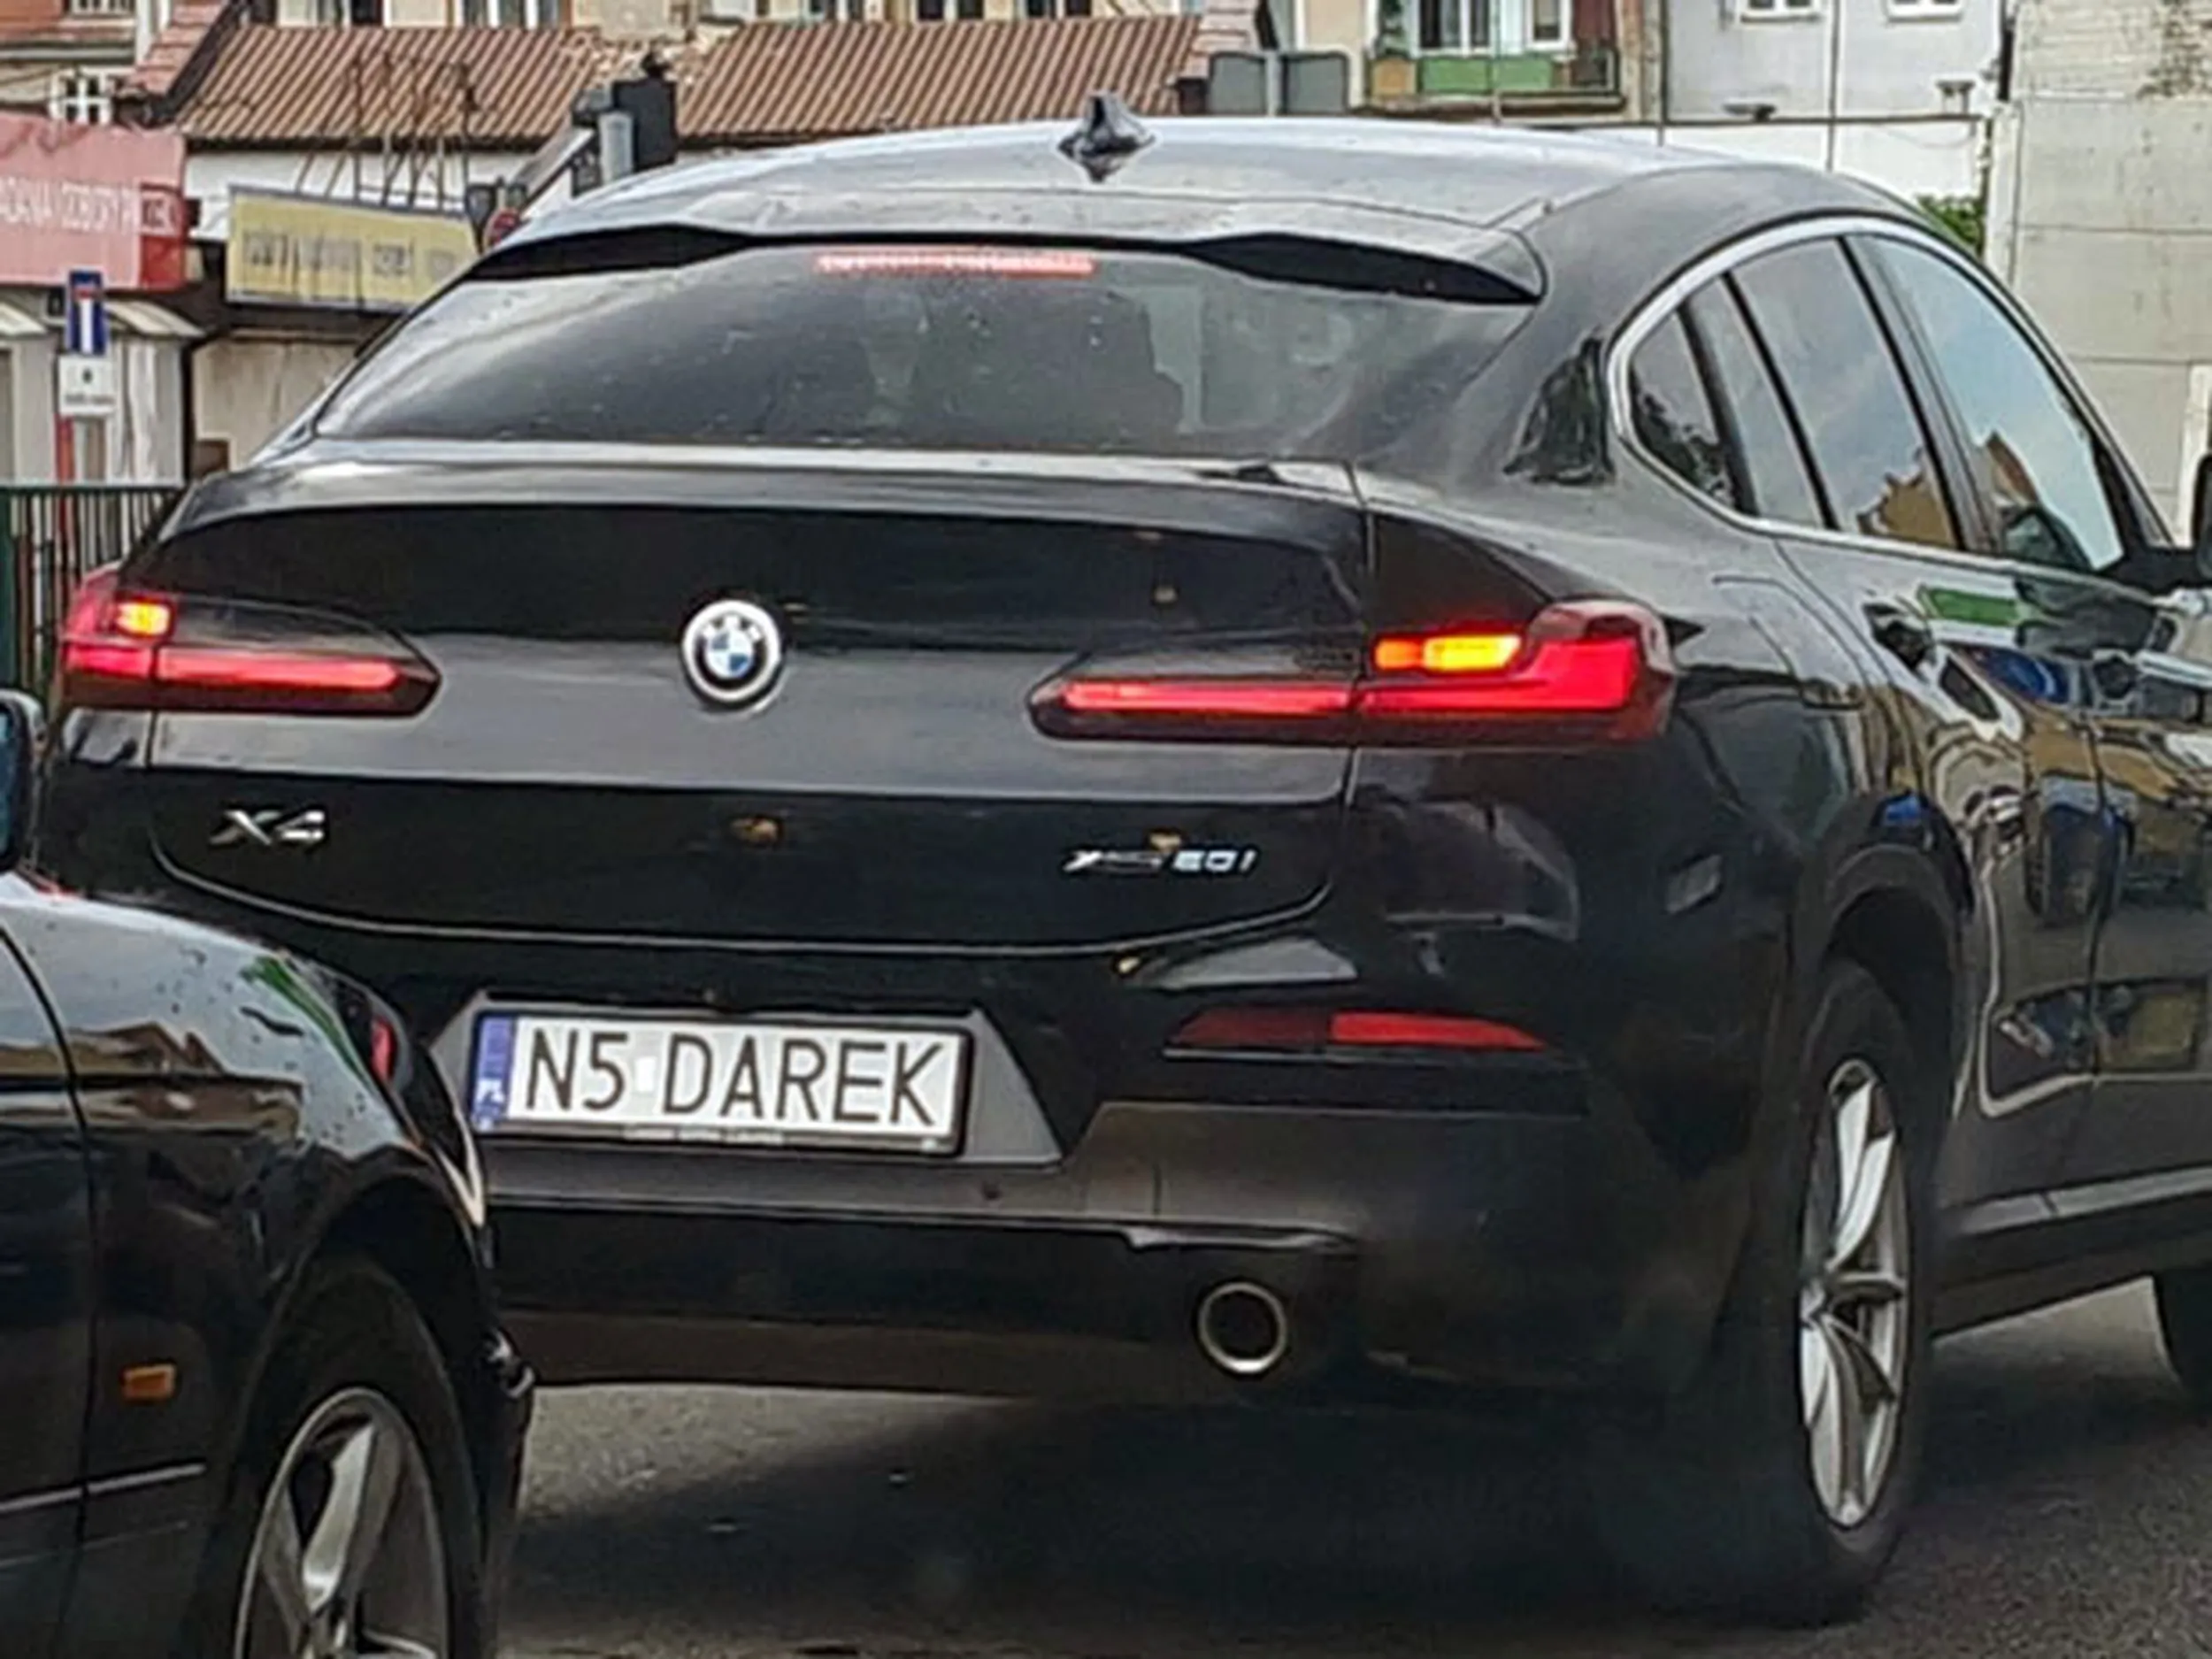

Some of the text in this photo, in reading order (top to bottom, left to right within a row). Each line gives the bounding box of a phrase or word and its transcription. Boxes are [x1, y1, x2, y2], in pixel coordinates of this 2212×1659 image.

[209, 809, 326, 846] X4
[526, 1028, 944, 1127] N5 DAREK
